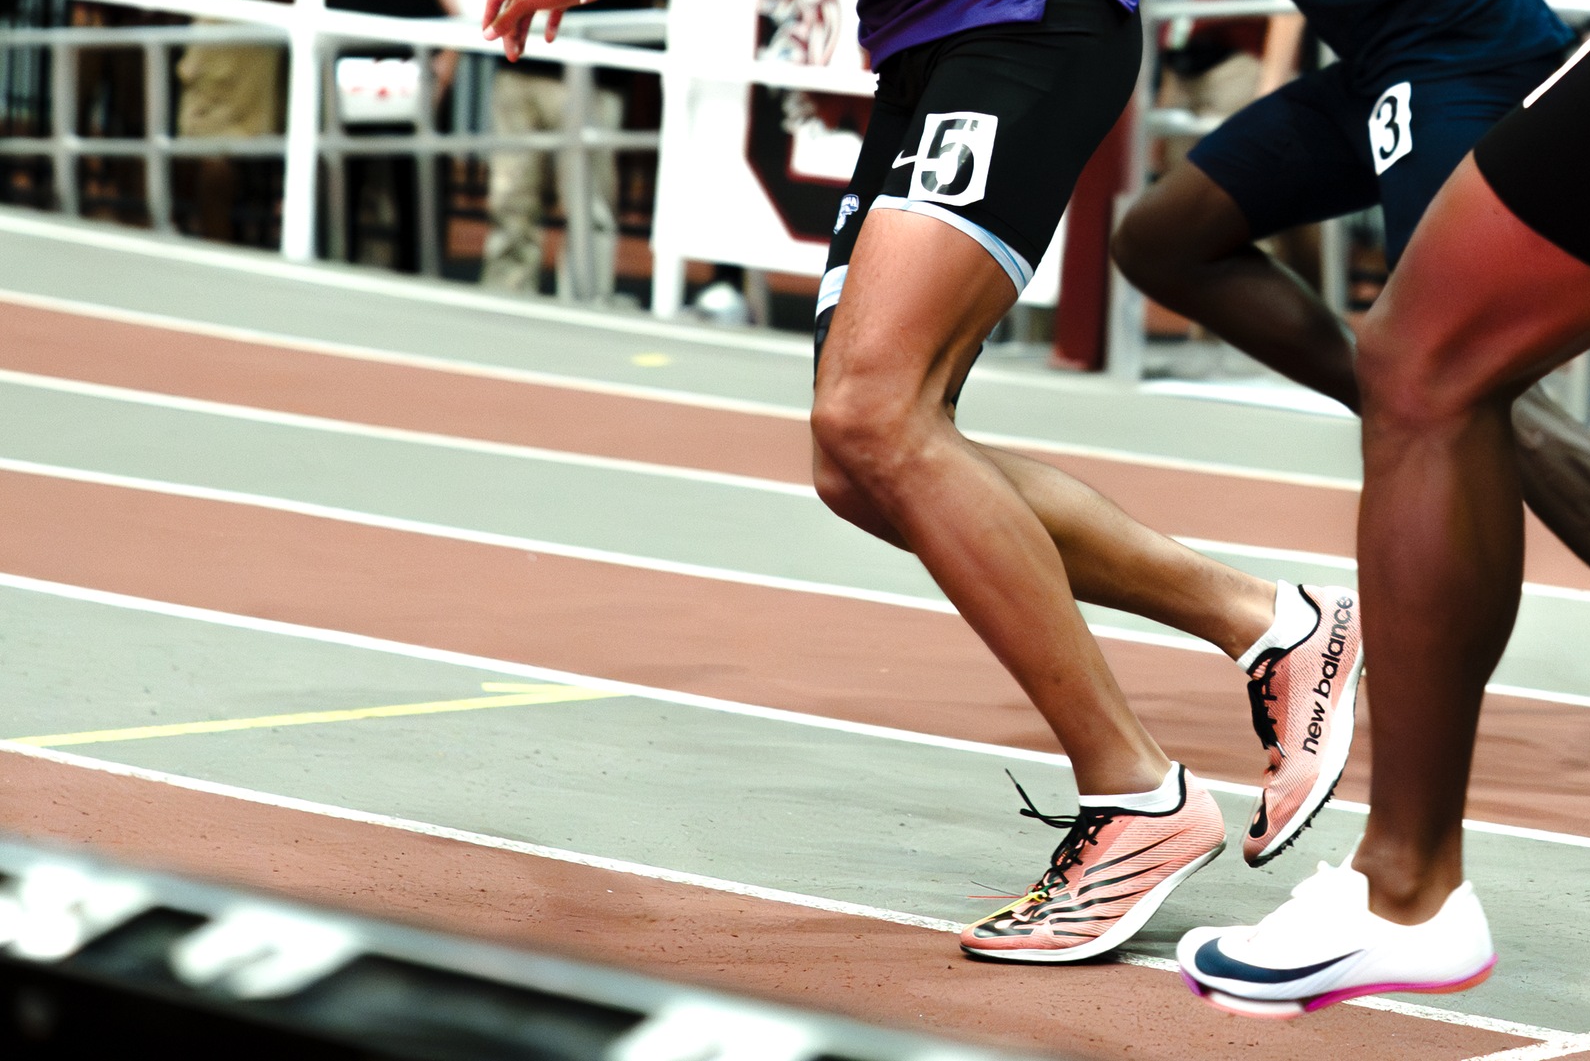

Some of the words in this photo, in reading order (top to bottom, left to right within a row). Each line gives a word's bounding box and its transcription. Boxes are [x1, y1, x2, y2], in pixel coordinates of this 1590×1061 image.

[920, 118, 980, 196] 5
[1376, 95, 1401, 160] 3
[1312, 596, 1354, 699] balance
[1302, 700, 1326, 755] new
